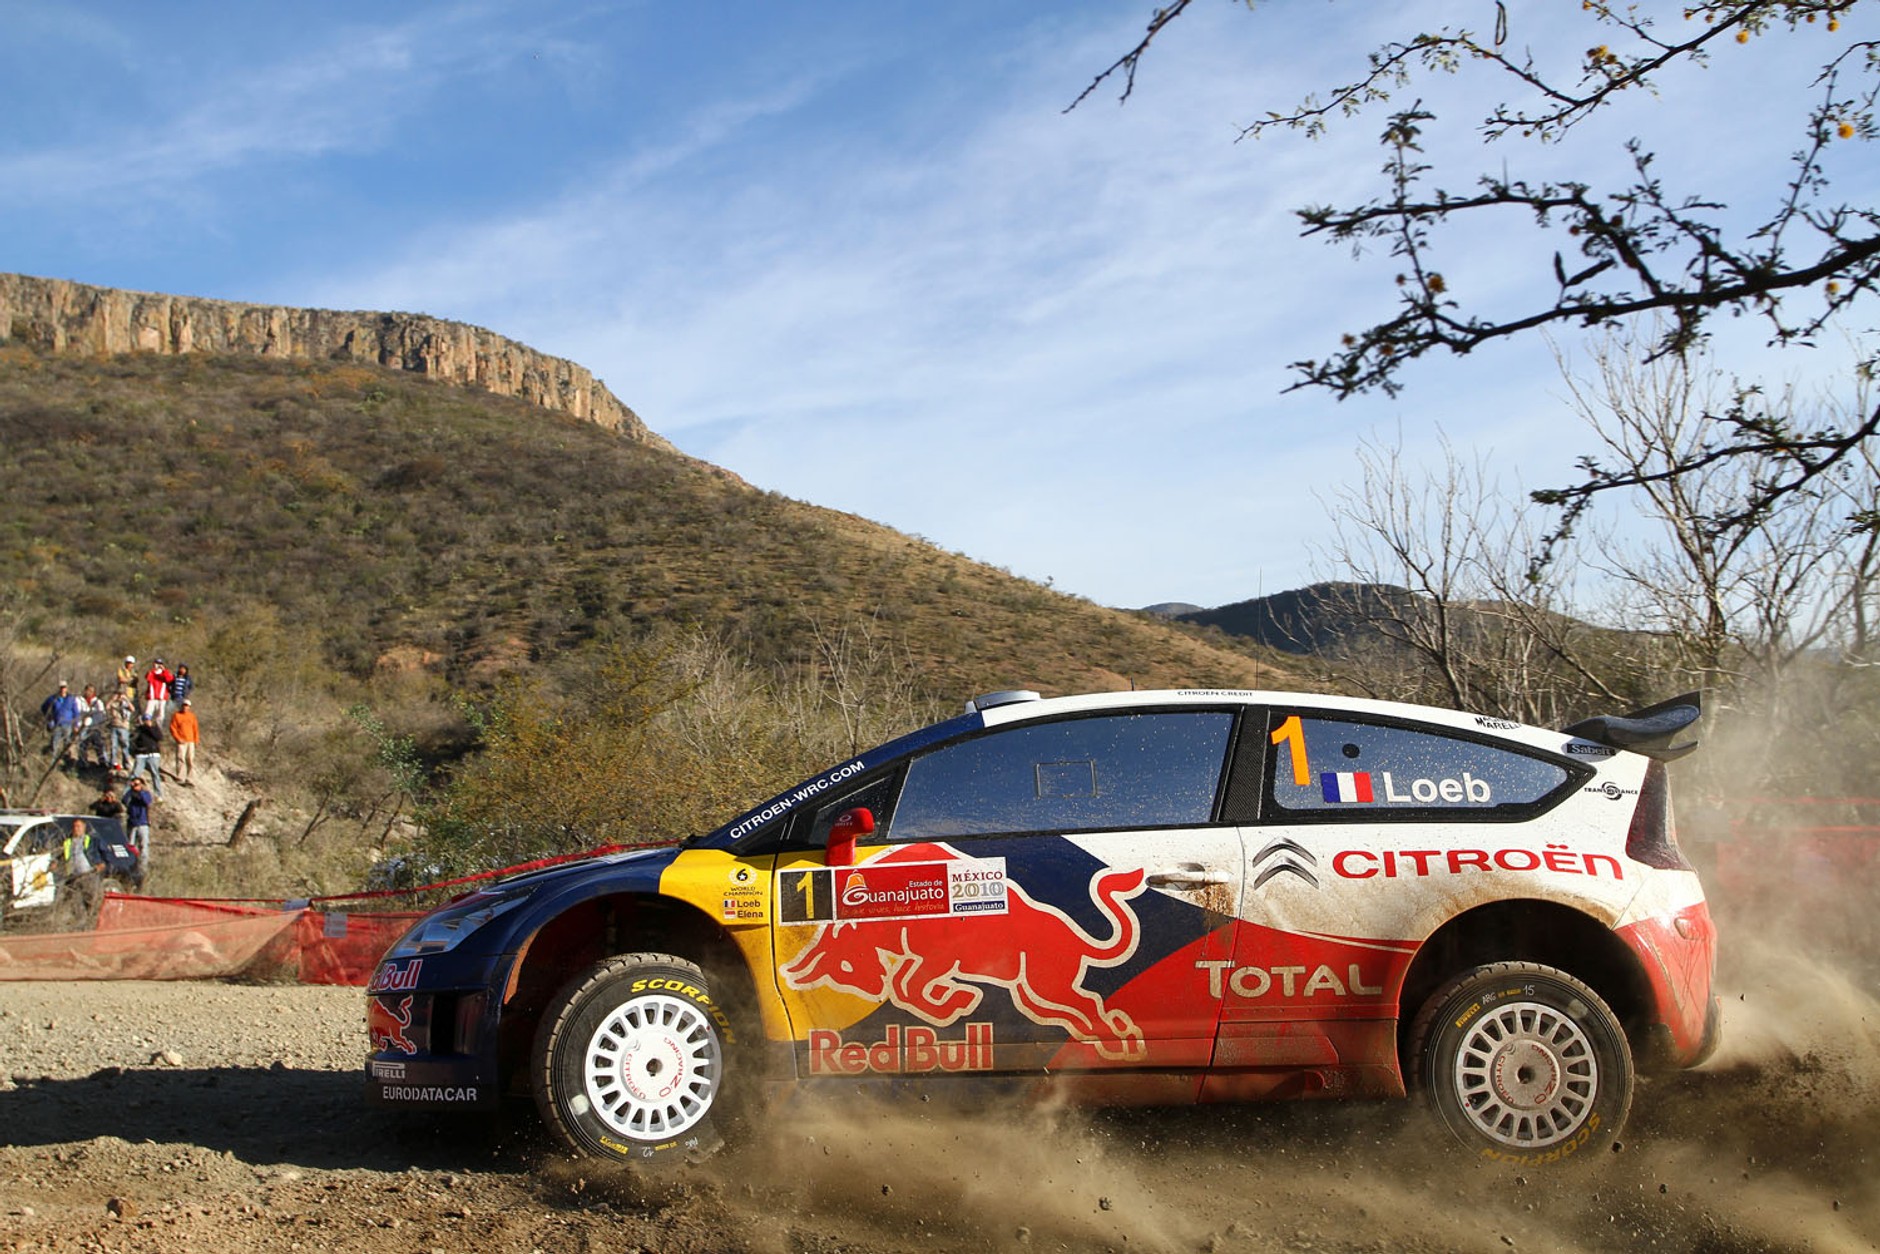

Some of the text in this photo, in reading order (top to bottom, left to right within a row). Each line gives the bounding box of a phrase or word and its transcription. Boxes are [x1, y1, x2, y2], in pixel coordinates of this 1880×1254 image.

[1271, 716, 1310, 786] 1
[1383, 772, 1491, 803] Loeb
[730, 761, 865, 839] CITROEN-WRC.COM
[736, 868, 748, 881] 6
[934, 879, 943, 887] de
[951, 869, 1004, 882] MÉXICO
[796, 871, 814, 919] 1
[842, 886, 944, 905] Guanajuato
[952, 881, 1004, 899] 2010
[737, 900, 761, 908] Loeb
[737, 910, 764, 918] Elena
[382, 959, 423, 990] Bull
[1195, 961, 1384, 998] TOTAL
[1523, 984, 1536, 996] 15
[631, 979, 737, 1045] SCORPION
[808, 1021, 995, 1075] Red Bull
[382, 1086, 478, 1101] EURODATACAR
